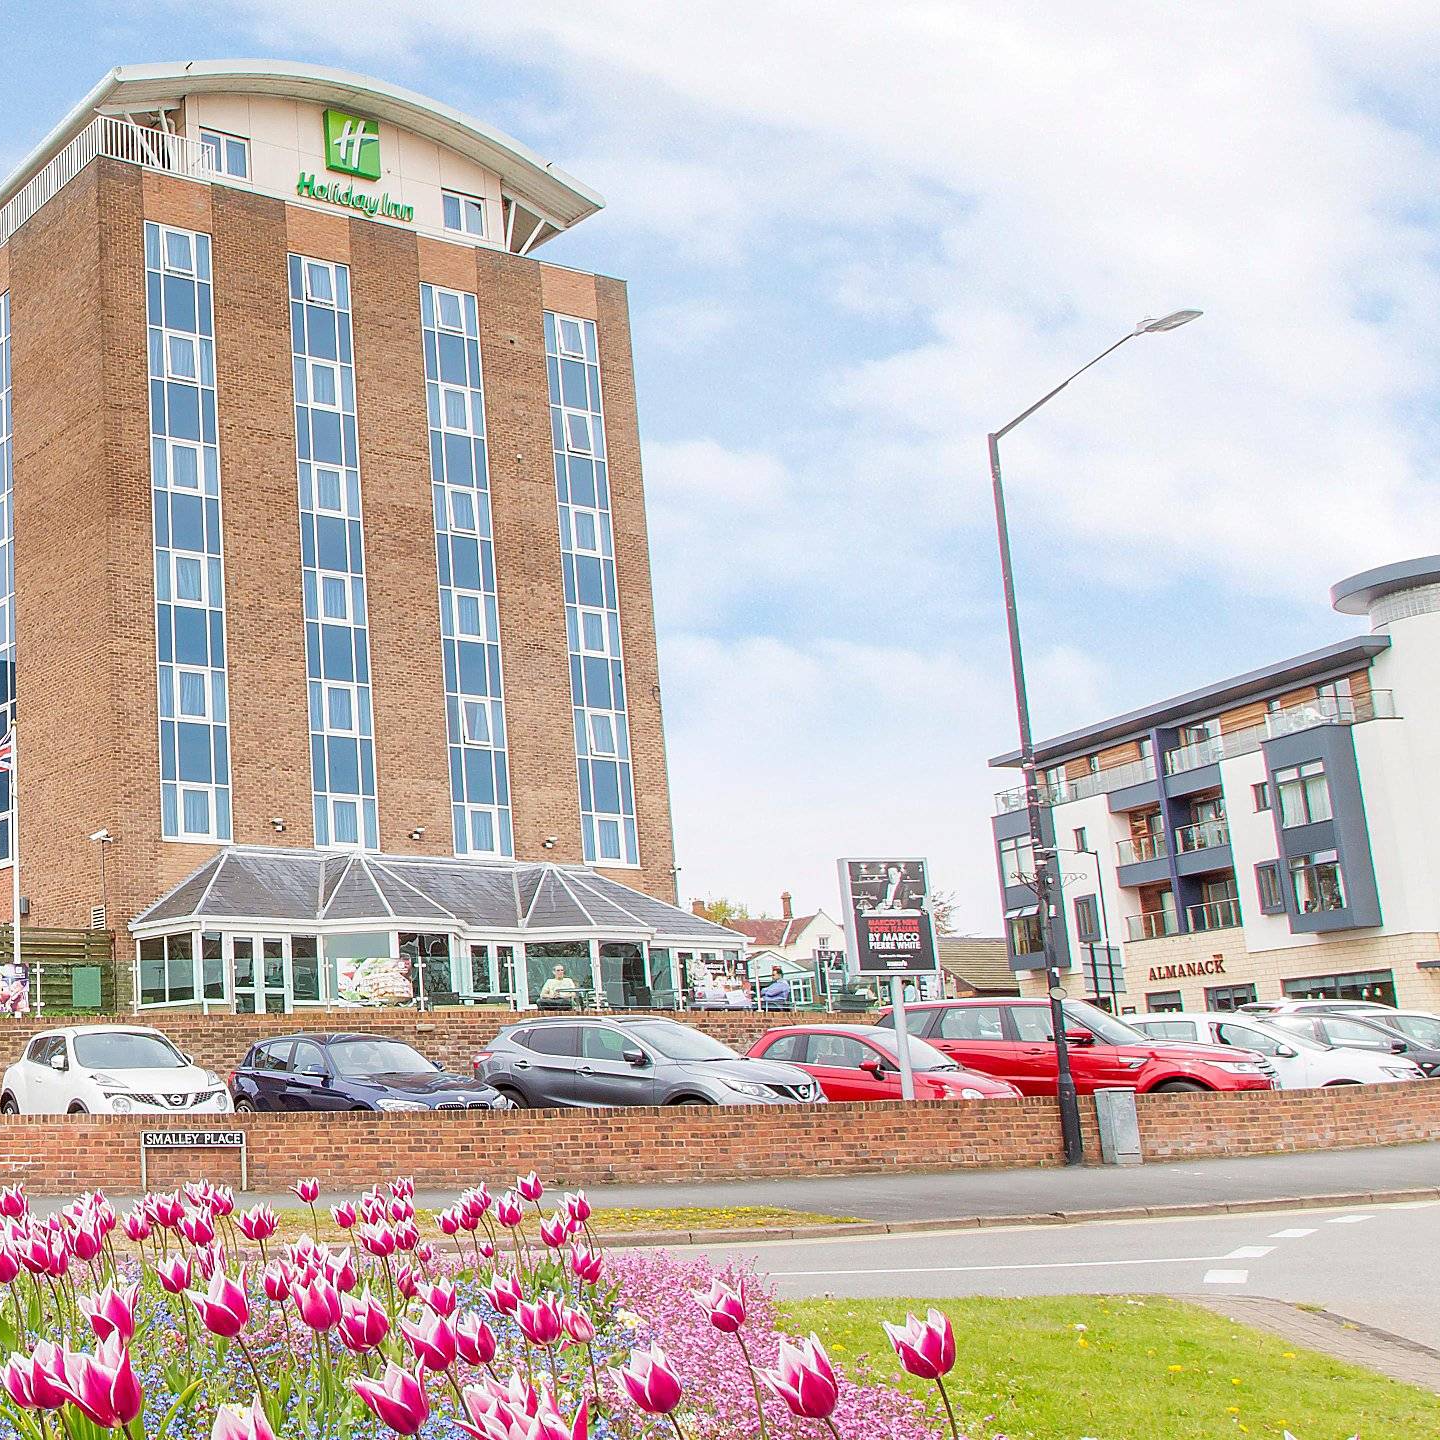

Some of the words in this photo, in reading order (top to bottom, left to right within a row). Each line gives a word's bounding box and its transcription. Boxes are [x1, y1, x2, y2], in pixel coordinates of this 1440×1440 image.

[297, 171, 380, 217] Holiday
[382, 192, 414, 222] Inn
[868, 933, 881, 941] BY
[882, 933, 920, 941] MARCO
[869, 941, 896, 949] PIERRE
[896, 941, 921, 949] WHITE
[1148, 960, 1226, 981] ALMANACK
[146, 1133, 200, 1144] SMALLEY
[204, 1133, 241, 1144] PLACE
